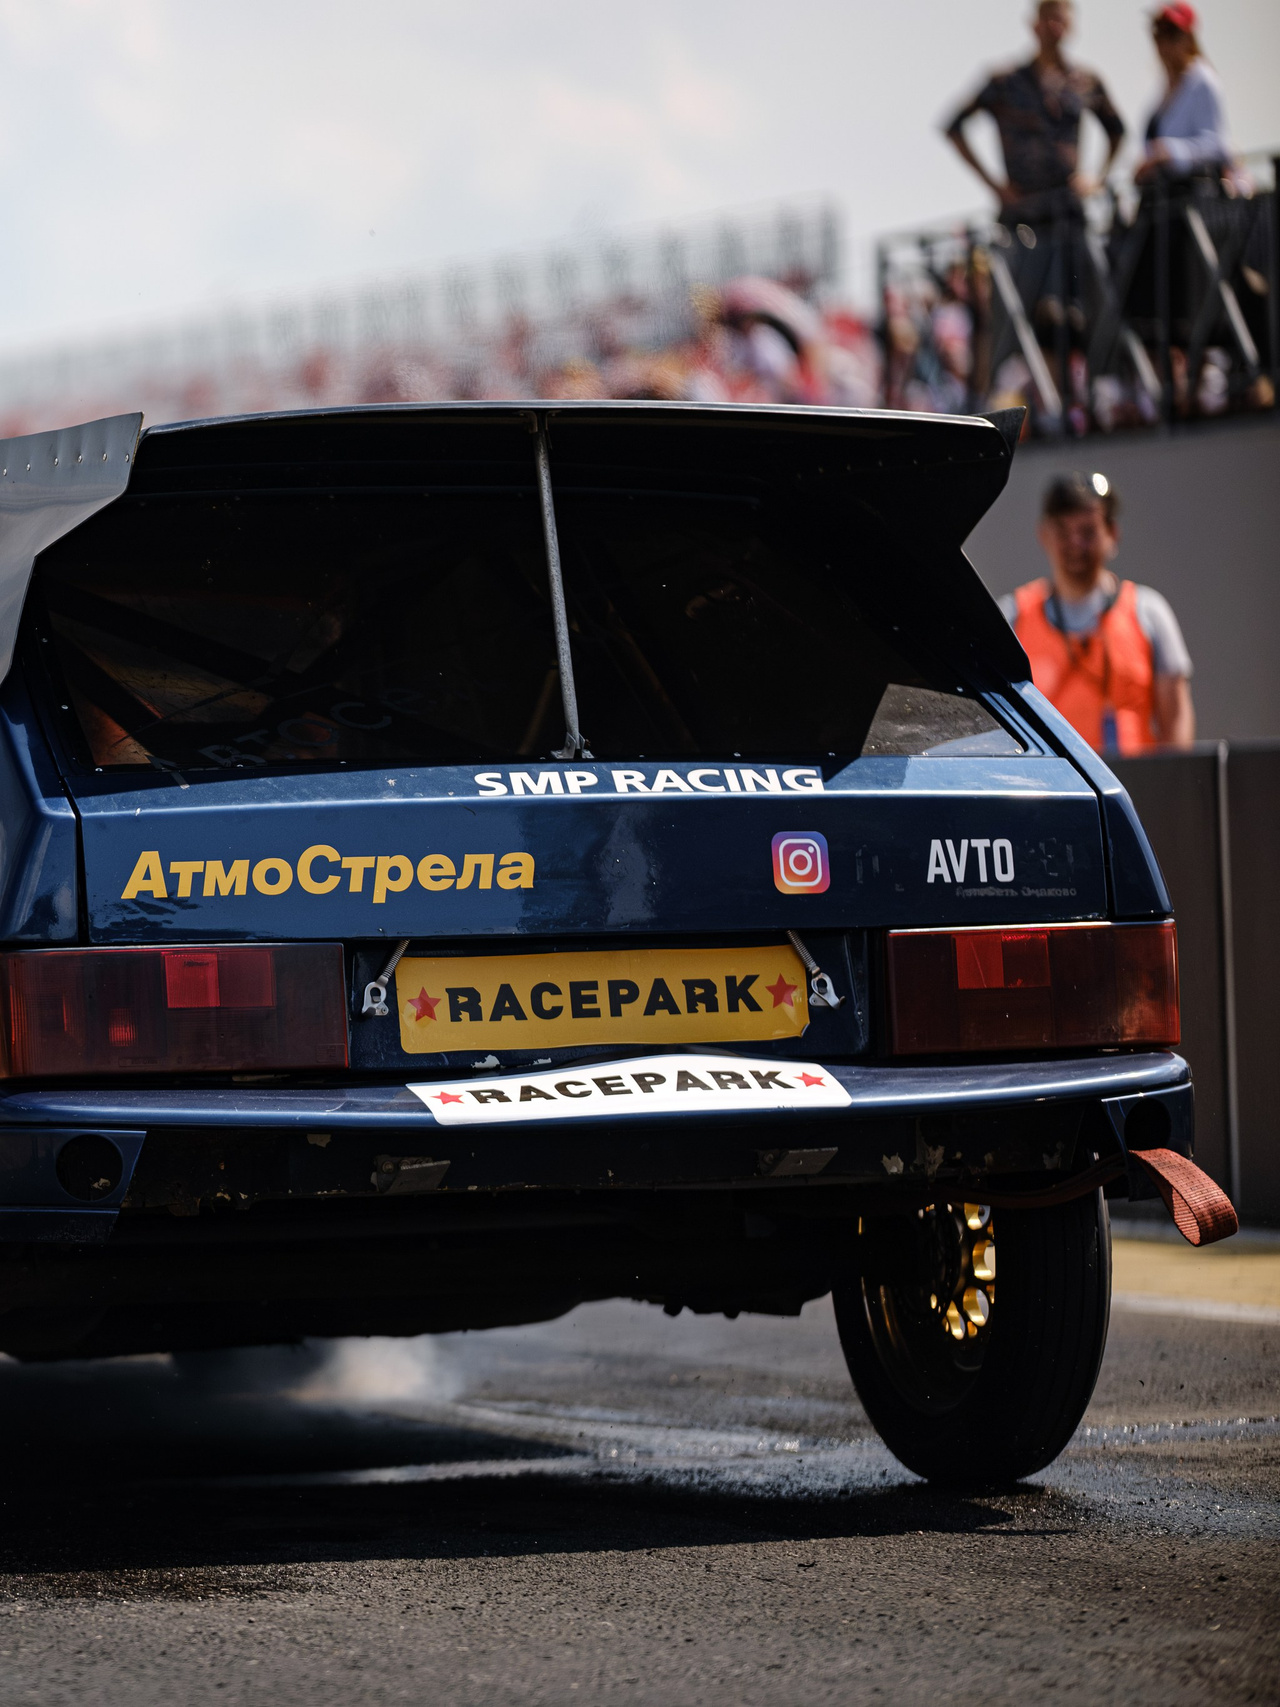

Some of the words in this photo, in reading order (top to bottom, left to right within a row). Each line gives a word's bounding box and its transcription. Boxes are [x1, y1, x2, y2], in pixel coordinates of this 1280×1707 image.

[473, 771, 599, 797] SMP
[610, 768, 825, 793] RACING
[120, 844, 536, 904] АтмоСтрела
[926, 838, 1015, 884] AVTO
[444, 973, 764, 1024] RACEPARK
[465, 1069, 797, 1104] RACEPARK
